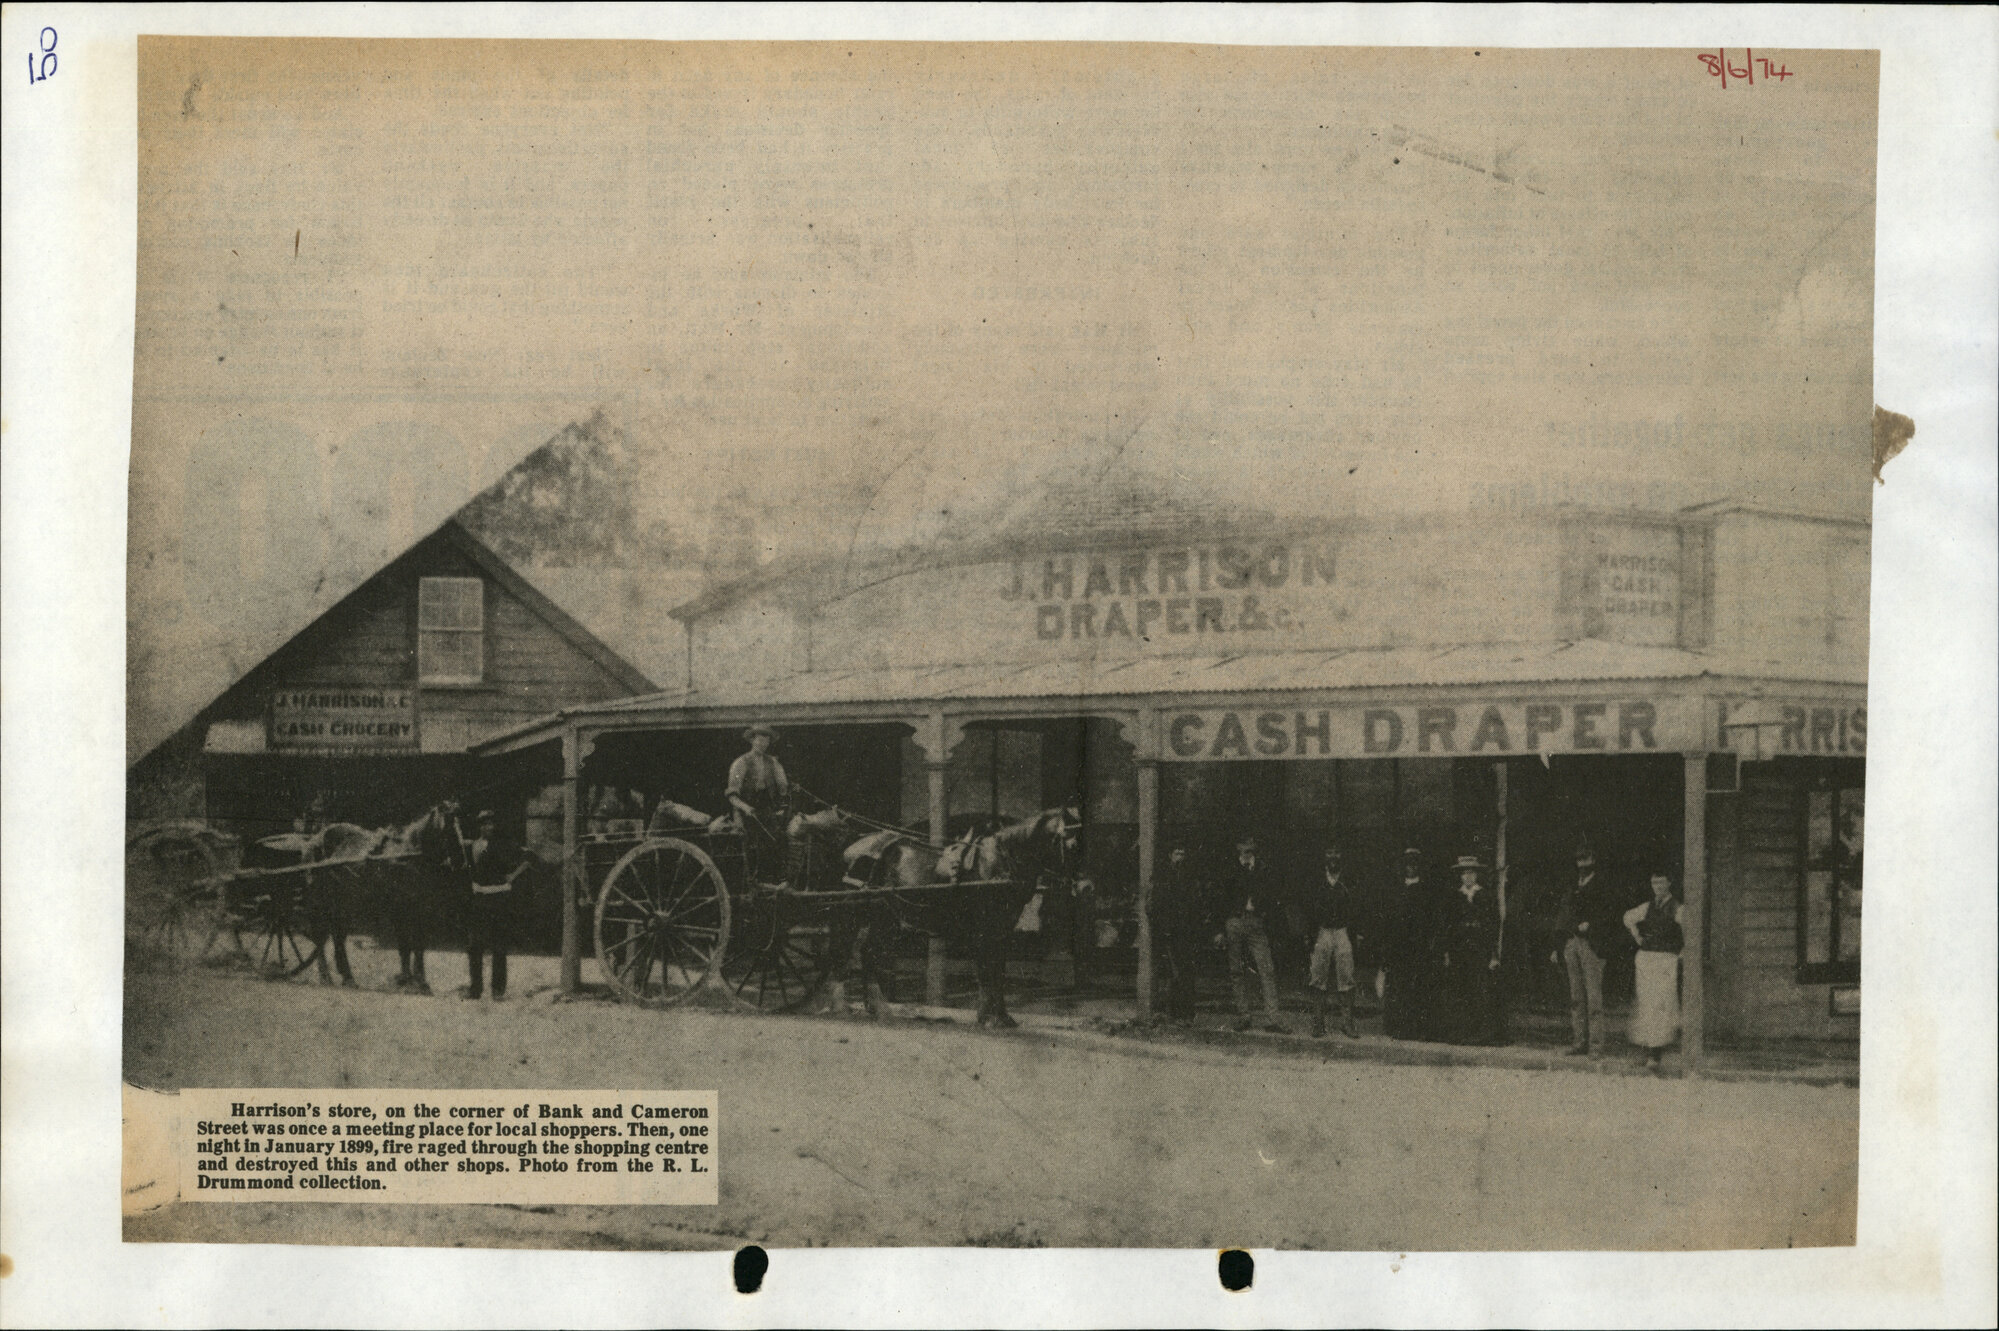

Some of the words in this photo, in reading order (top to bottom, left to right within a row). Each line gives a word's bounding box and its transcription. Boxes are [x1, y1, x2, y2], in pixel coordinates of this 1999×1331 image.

[28, 26, 58, 85] 50
[1697, 48, 1794, 90] 8/6/74
[275, 722, 324, 737] CASH
[329, 721, 411, 738] GROCERY
[1169, 709, 1332, 758] CASH
[1364, 702, 1658, 756] DRAPER
